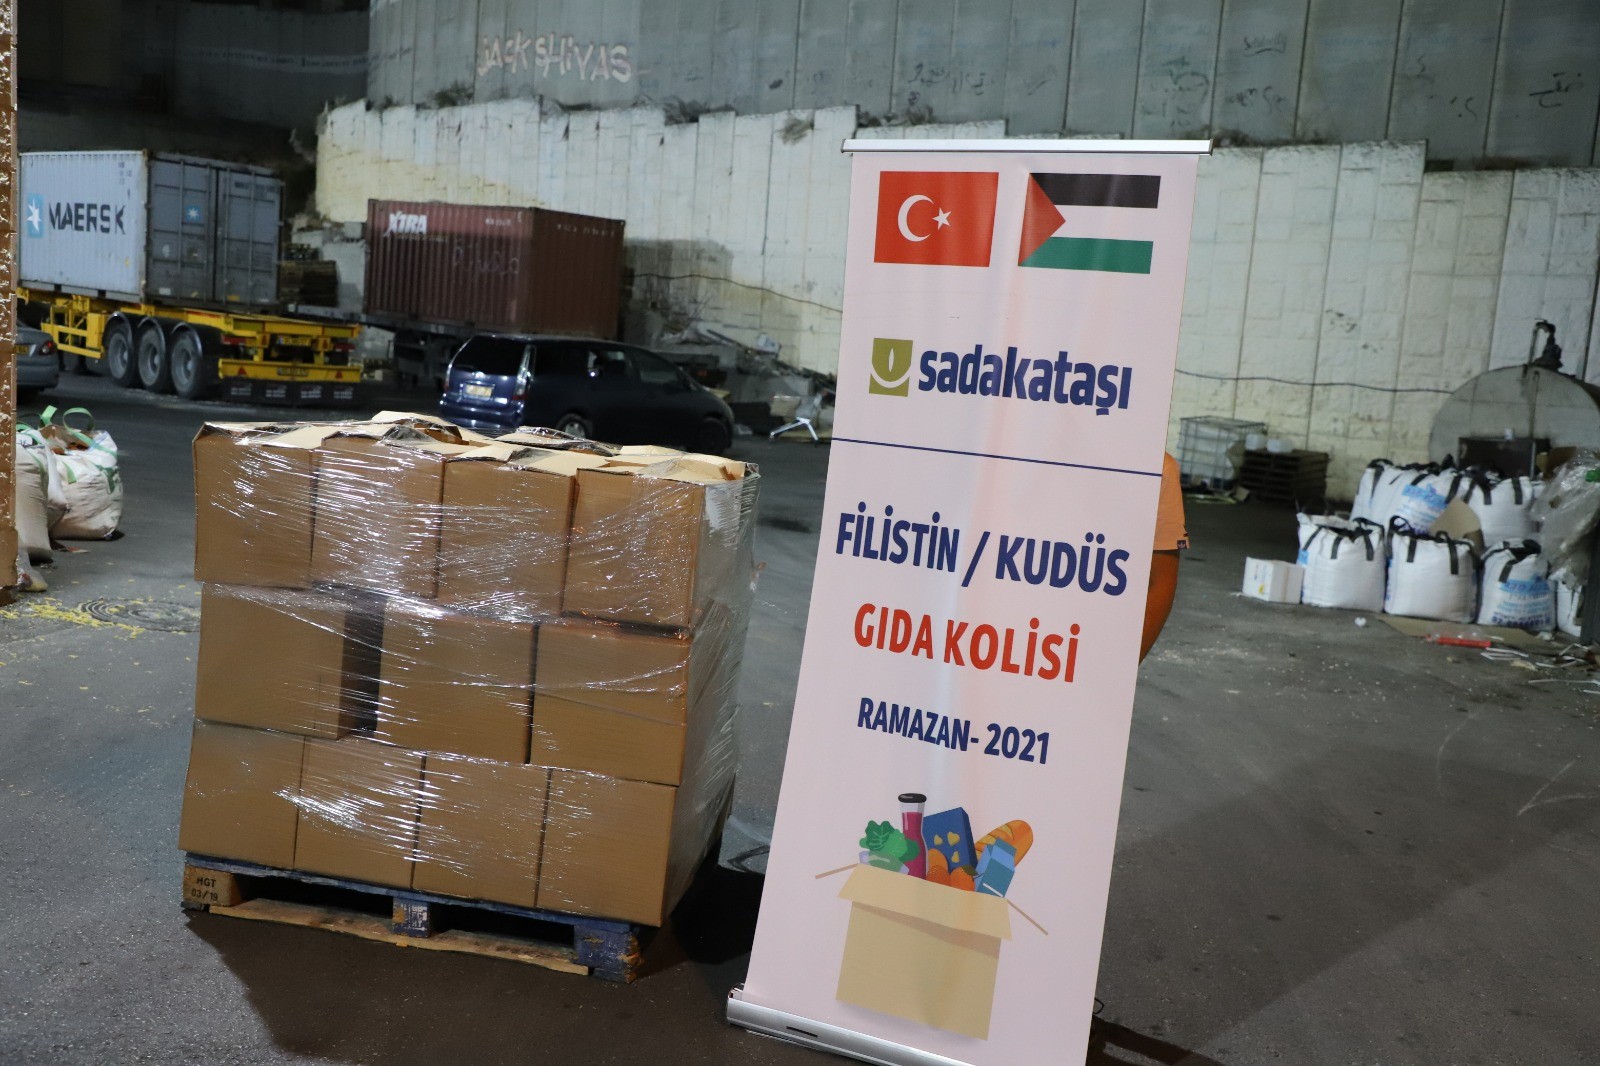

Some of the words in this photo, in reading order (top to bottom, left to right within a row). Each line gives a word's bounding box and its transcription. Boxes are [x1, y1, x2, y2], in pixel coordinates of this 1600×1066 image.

[49, 202, 127, 235] MAERSK
[383, 211, 428, 237] XTRA
[918, 344, 1133, 416] sadakataşı
[836, 501, 960, 573] FİLİSTİN
[961, 531, 991, 588] /
[995, 532, 1130, 596] KUDÜS
[854, 603, 934, 660] GIDA
[943, 617, 1081, 683] KOLİSİ
[983, 722, 1050, 765] 2021
[191, 888, 219, 901] 03/19
